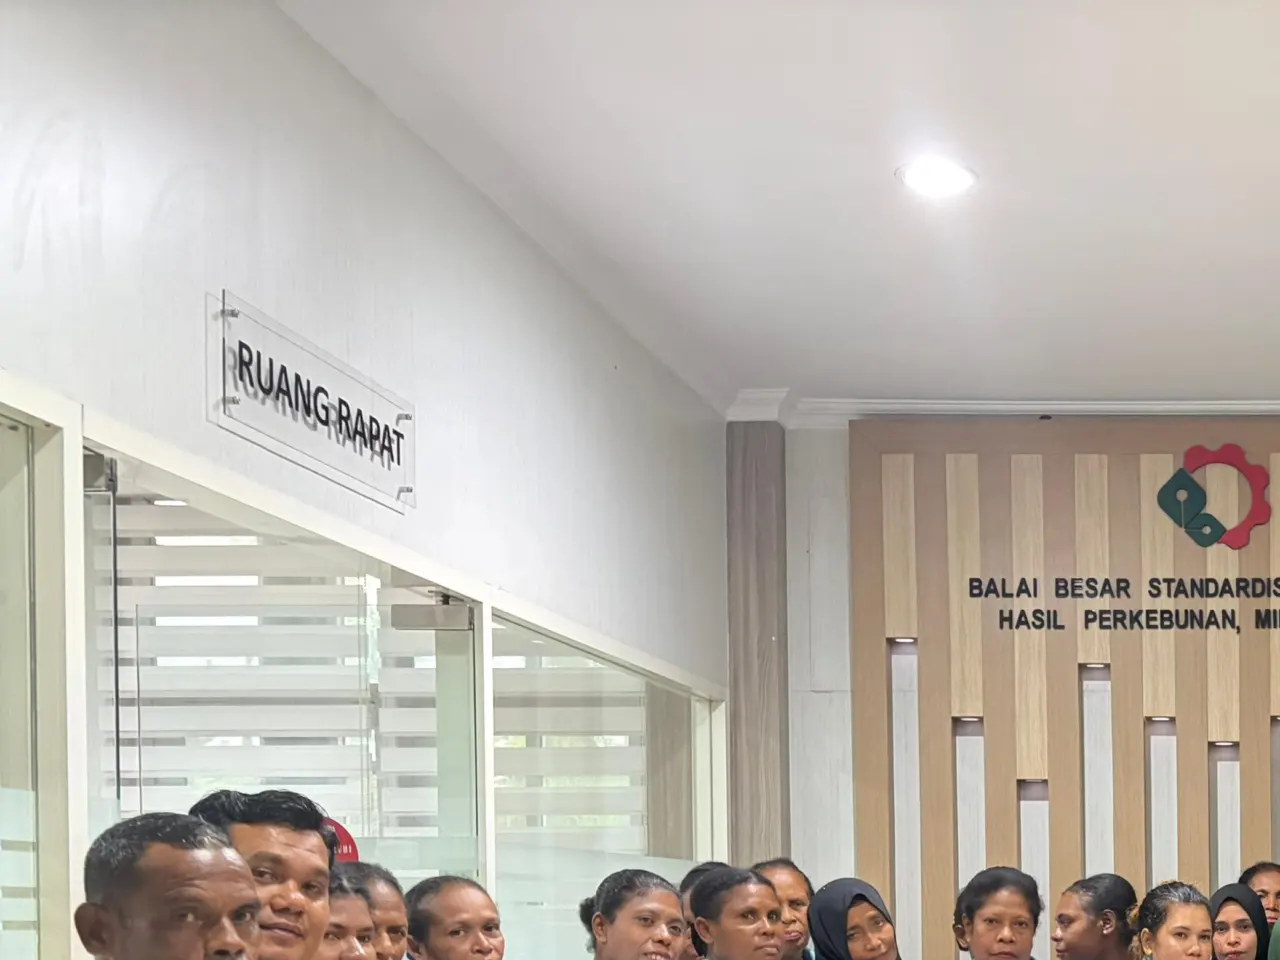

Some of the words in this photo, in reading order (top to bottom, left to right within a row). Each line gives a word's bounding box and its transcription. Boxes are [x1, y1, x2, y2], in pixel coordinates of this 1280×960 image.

[238, 339, 329, 427] RUANG
[337, 396, 405, 467] RAPAT
[969, 577, 1038, 598] BALAI
[1055, 577, 1131, 598] BESAR
[999, 608, 1065, 630] HASIL
[1084, 608, 1241, 634] PERKEBUNAN,
